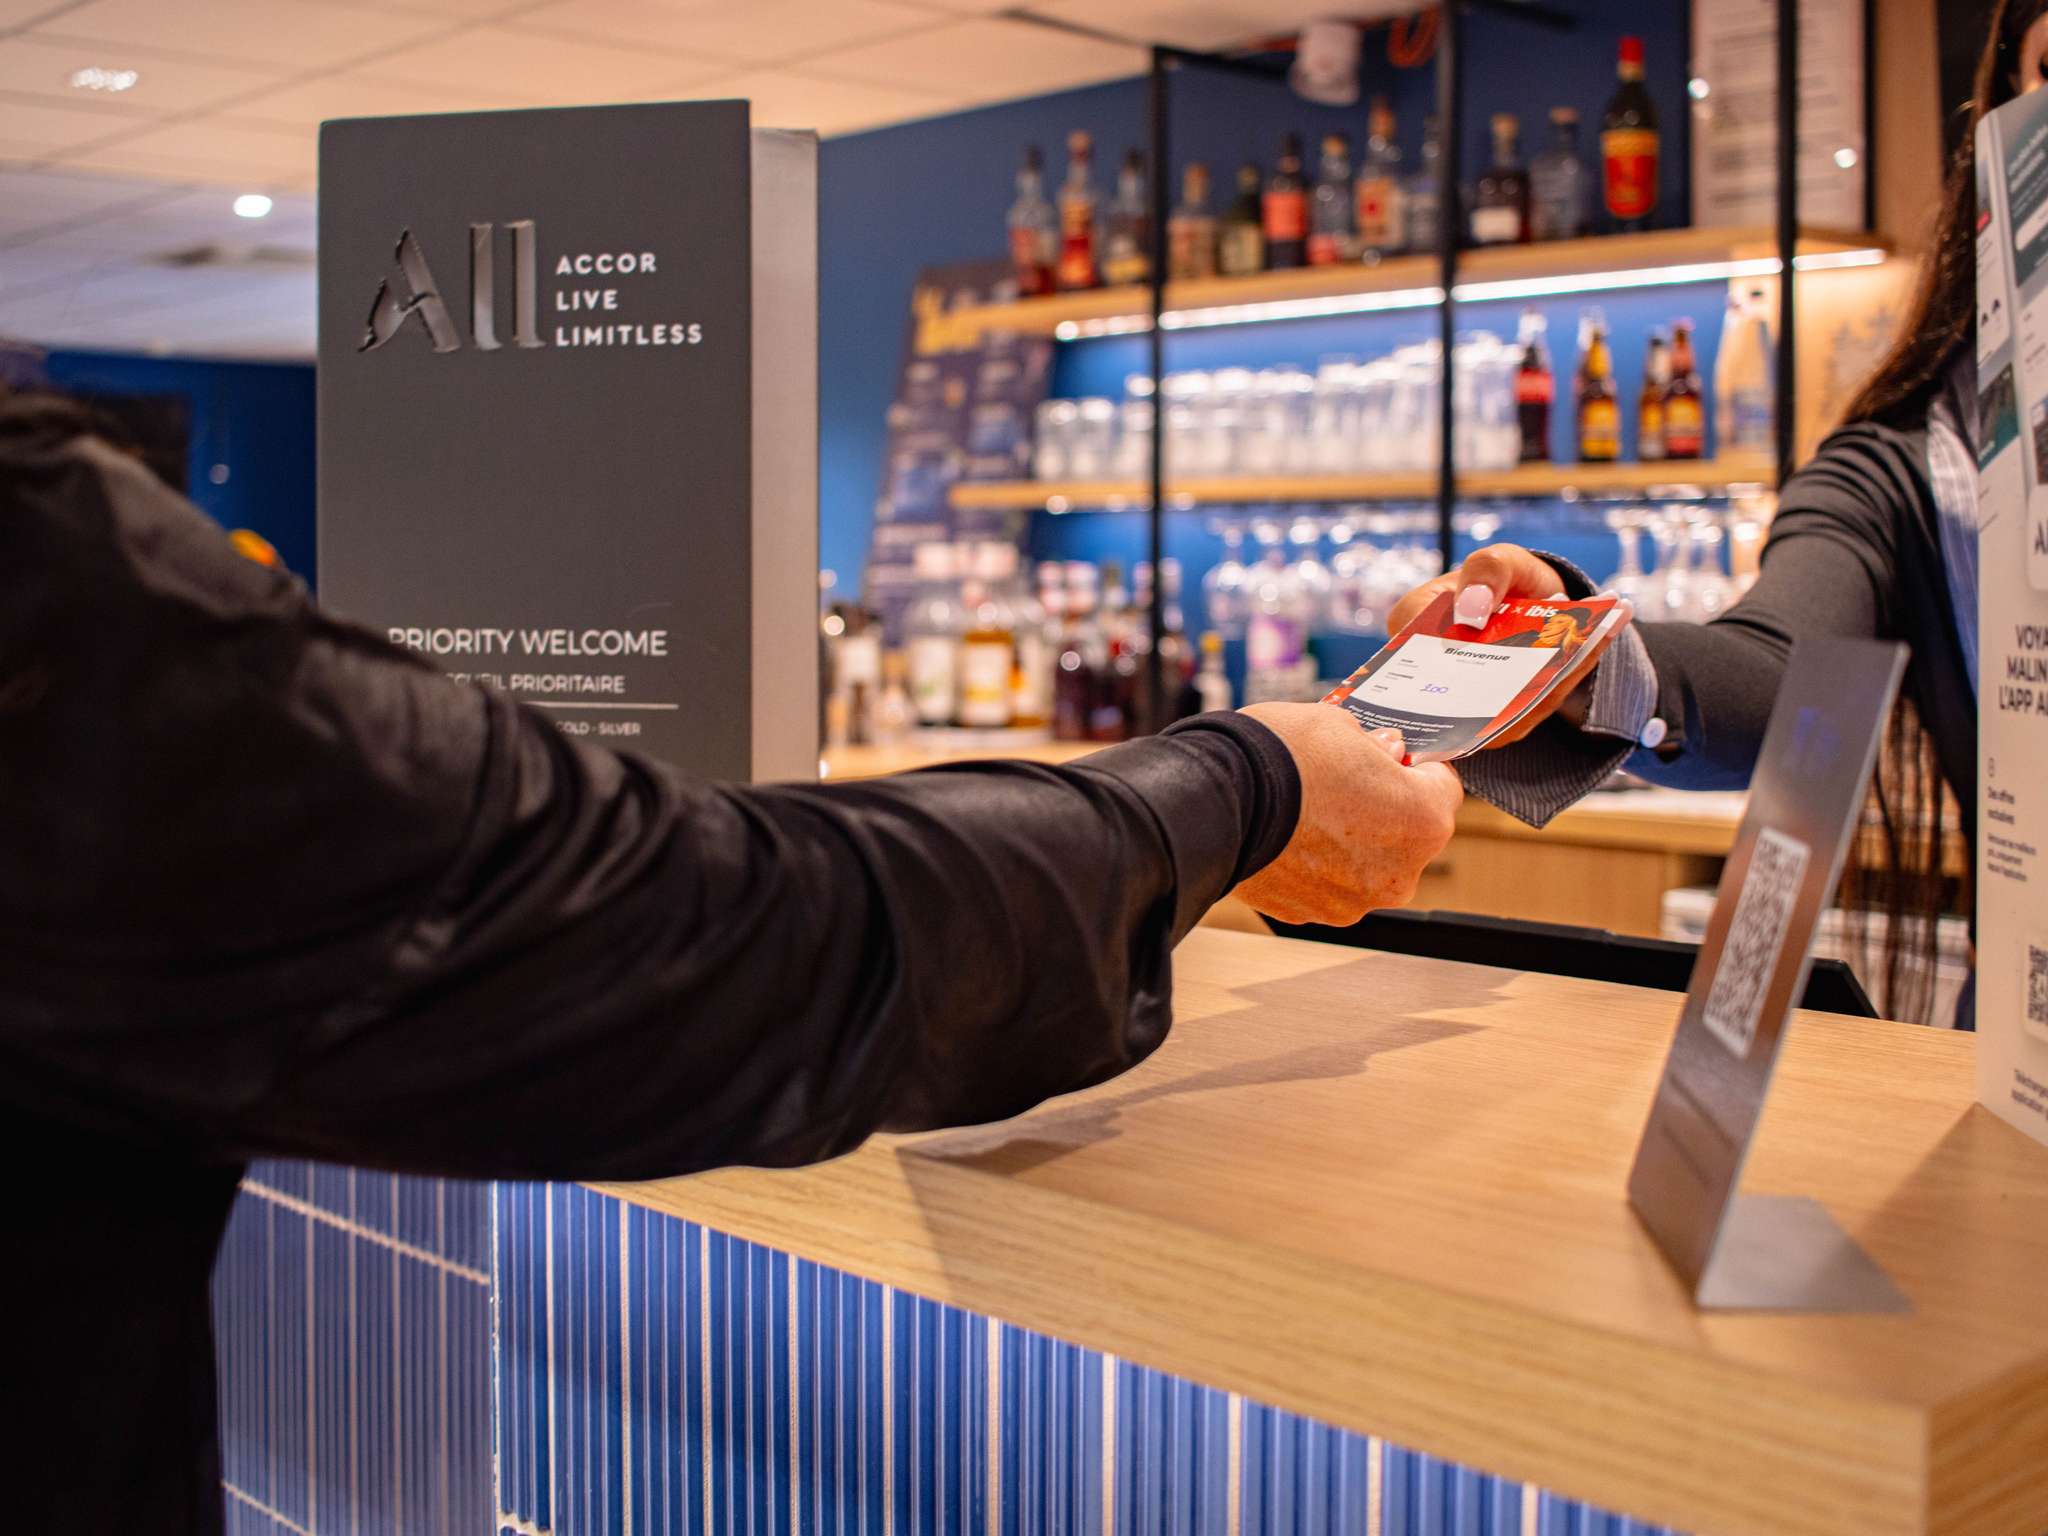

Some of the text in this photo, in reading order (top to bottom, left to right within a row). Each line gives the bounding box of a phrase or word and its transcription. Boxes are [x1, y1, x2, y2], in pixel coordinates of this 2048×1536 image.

[556, 252, 657, 275] ACCOR
[357, 219, 546, 353] All
[556, 289, 618, 311] LIVE
[556, 323, 703, 347] LIMITLESS
[1524, 605, 1559, 618] ibis
[388, 627, 668, 656] PRIORITY WELCOME
[1444, 647, 1511, 662] Bienvenue
[511, 673, 626, 694] PRIORITAIRE
